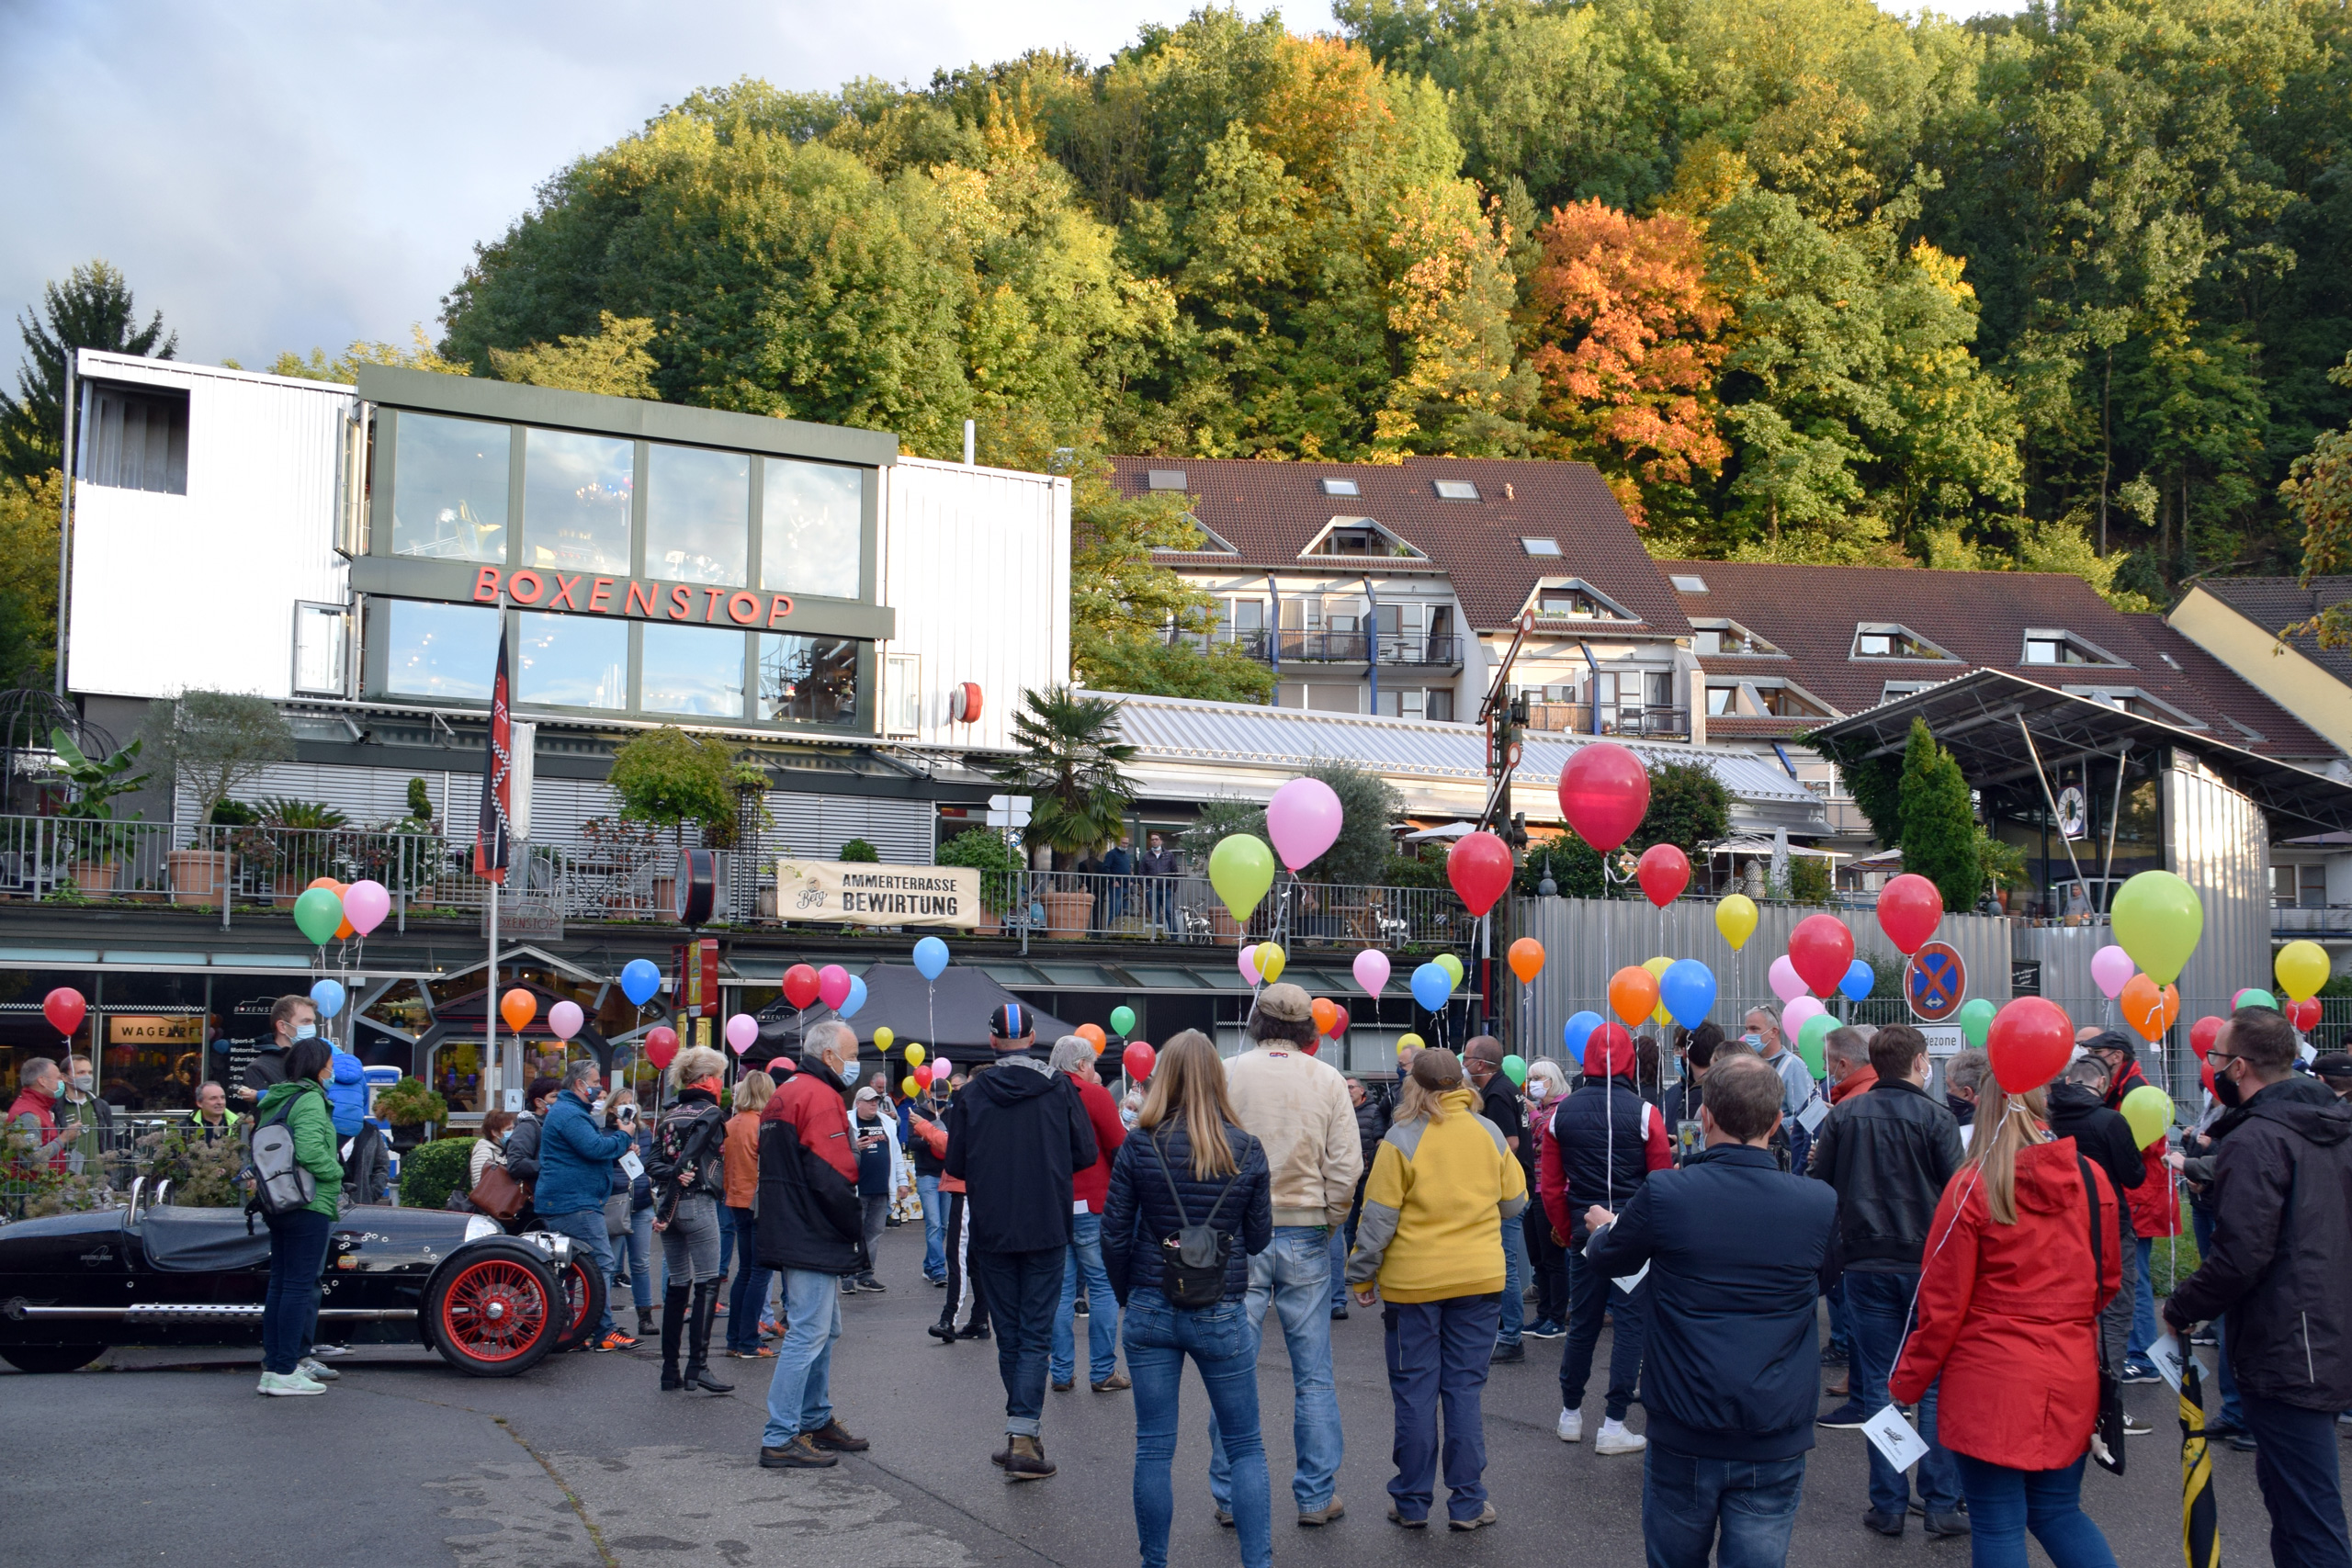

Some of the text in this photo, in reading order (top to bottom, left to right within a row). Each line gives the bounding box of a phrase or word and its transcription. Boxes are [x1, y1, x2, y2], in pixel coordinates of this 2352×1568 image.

[473, 566, 794, 627] BOXENSTOP
[842, 874, 957, 892] AMMERTERRASSE
[796, 887, 829, 910] Berg
[842, 892, 958, 916] BEWIRTUNG
[1925, 1034, 1957, 1046] dezone
